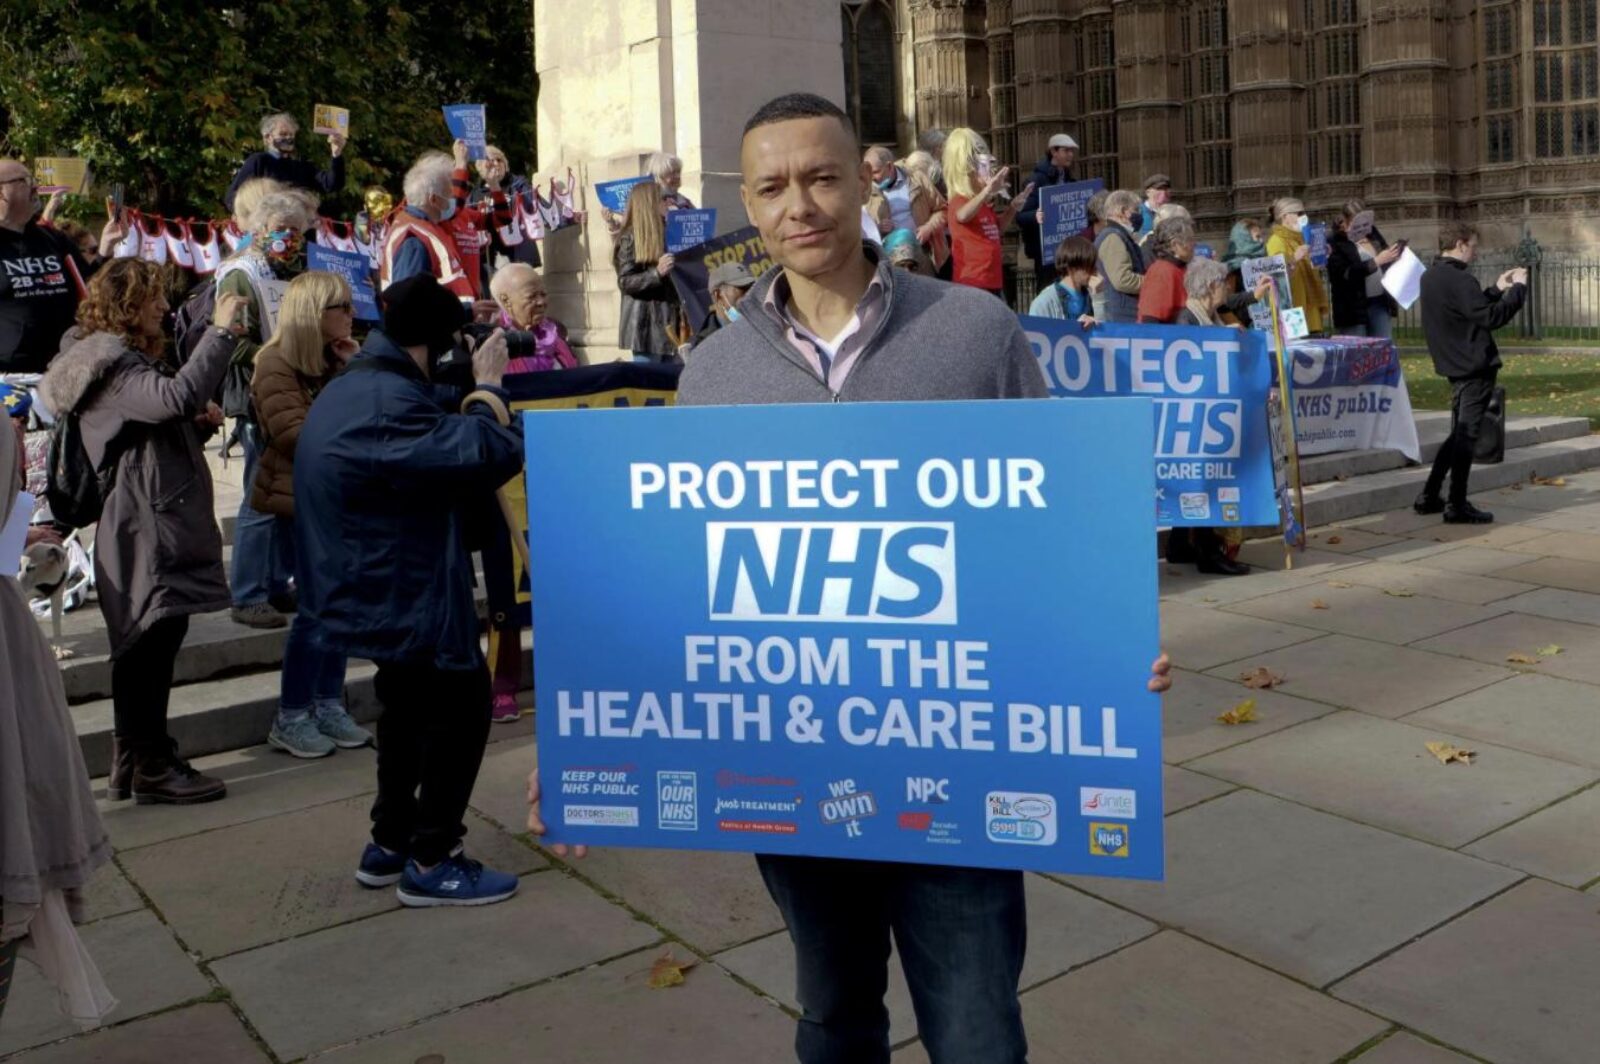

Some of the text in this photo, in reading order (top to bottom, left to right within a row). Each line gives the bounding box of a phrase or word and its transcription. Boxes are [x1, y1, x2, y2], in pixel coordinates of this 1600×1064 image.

[1060, 203, 1085, 220] NHS
[3, 255, 62, 276] NHS
[1025, 331, 1240, 395] ROTECT
[1296, 391, 1393, 420] NHS publc
[1154, 401, 1238, 456] HS
[1156, 462, 1236, 480] CARE BILL
[630, 458, 1047, 510] PROTECT OUR
[711, 526, 950, 619] NHS
[685, 635, 989, 690] FROM THE
[558, 691, 1137, 759] HEALTH & CARE BILL
[561, 770, 627, 783] KEEP OUR
[562, 783, 639, 795] NHS PUBLIC
[661, 785, 693, 802] OUR
[828, 778, 857, 798] we
[906, 777, 949, 803] NPC
[567, 808, 605, 818] DOCTORS
[662, 802, 694, 820] NHS
[714, 797, 796, 814] just TREATMENT
[823, 795, 873, 820] own
[846, 820, 863, 838] it
[1098, 832, 1122, 847] NHS
